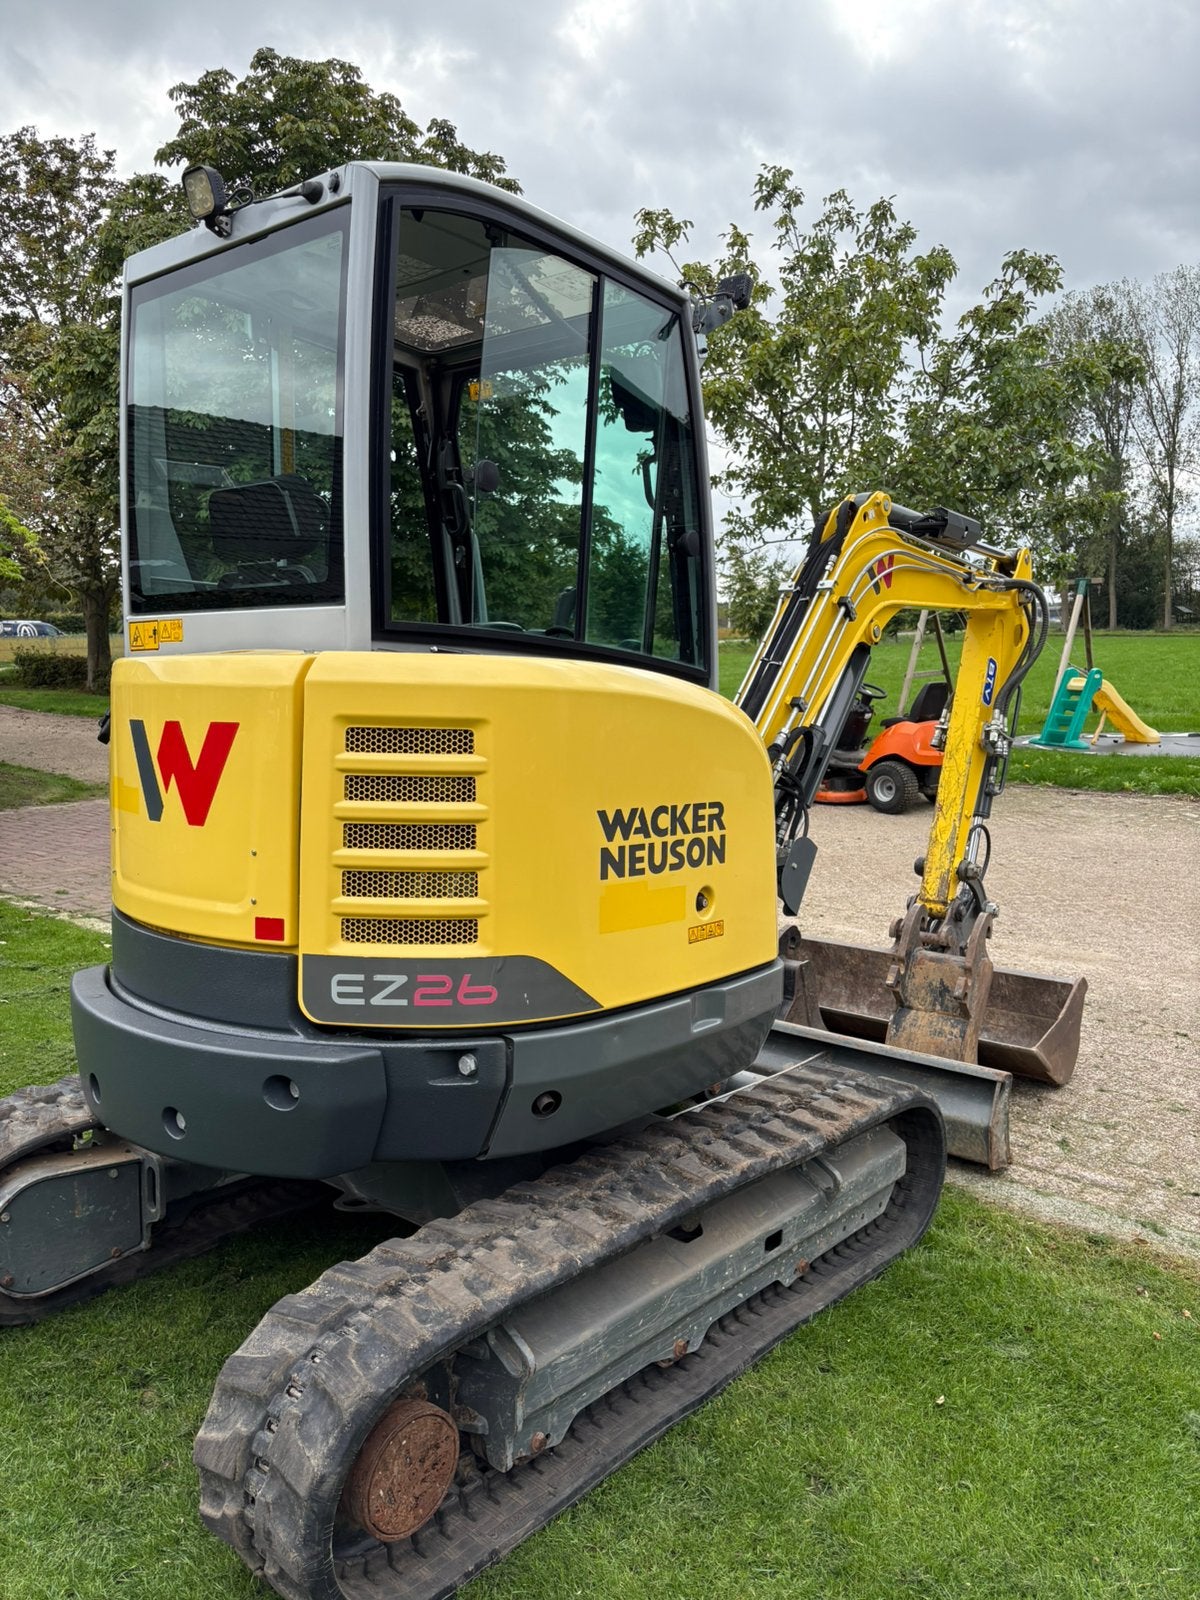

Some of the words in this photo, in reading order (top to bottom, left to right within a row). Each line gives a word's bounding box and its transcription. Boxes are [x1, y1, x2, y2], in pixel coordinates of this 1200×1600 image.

[128, 718, 241, 827] W
[596, 801, 727, 843] WACKER
[600, 834, 727, 881] NEUSON
[330, 973, 499, 1007] EZ26
